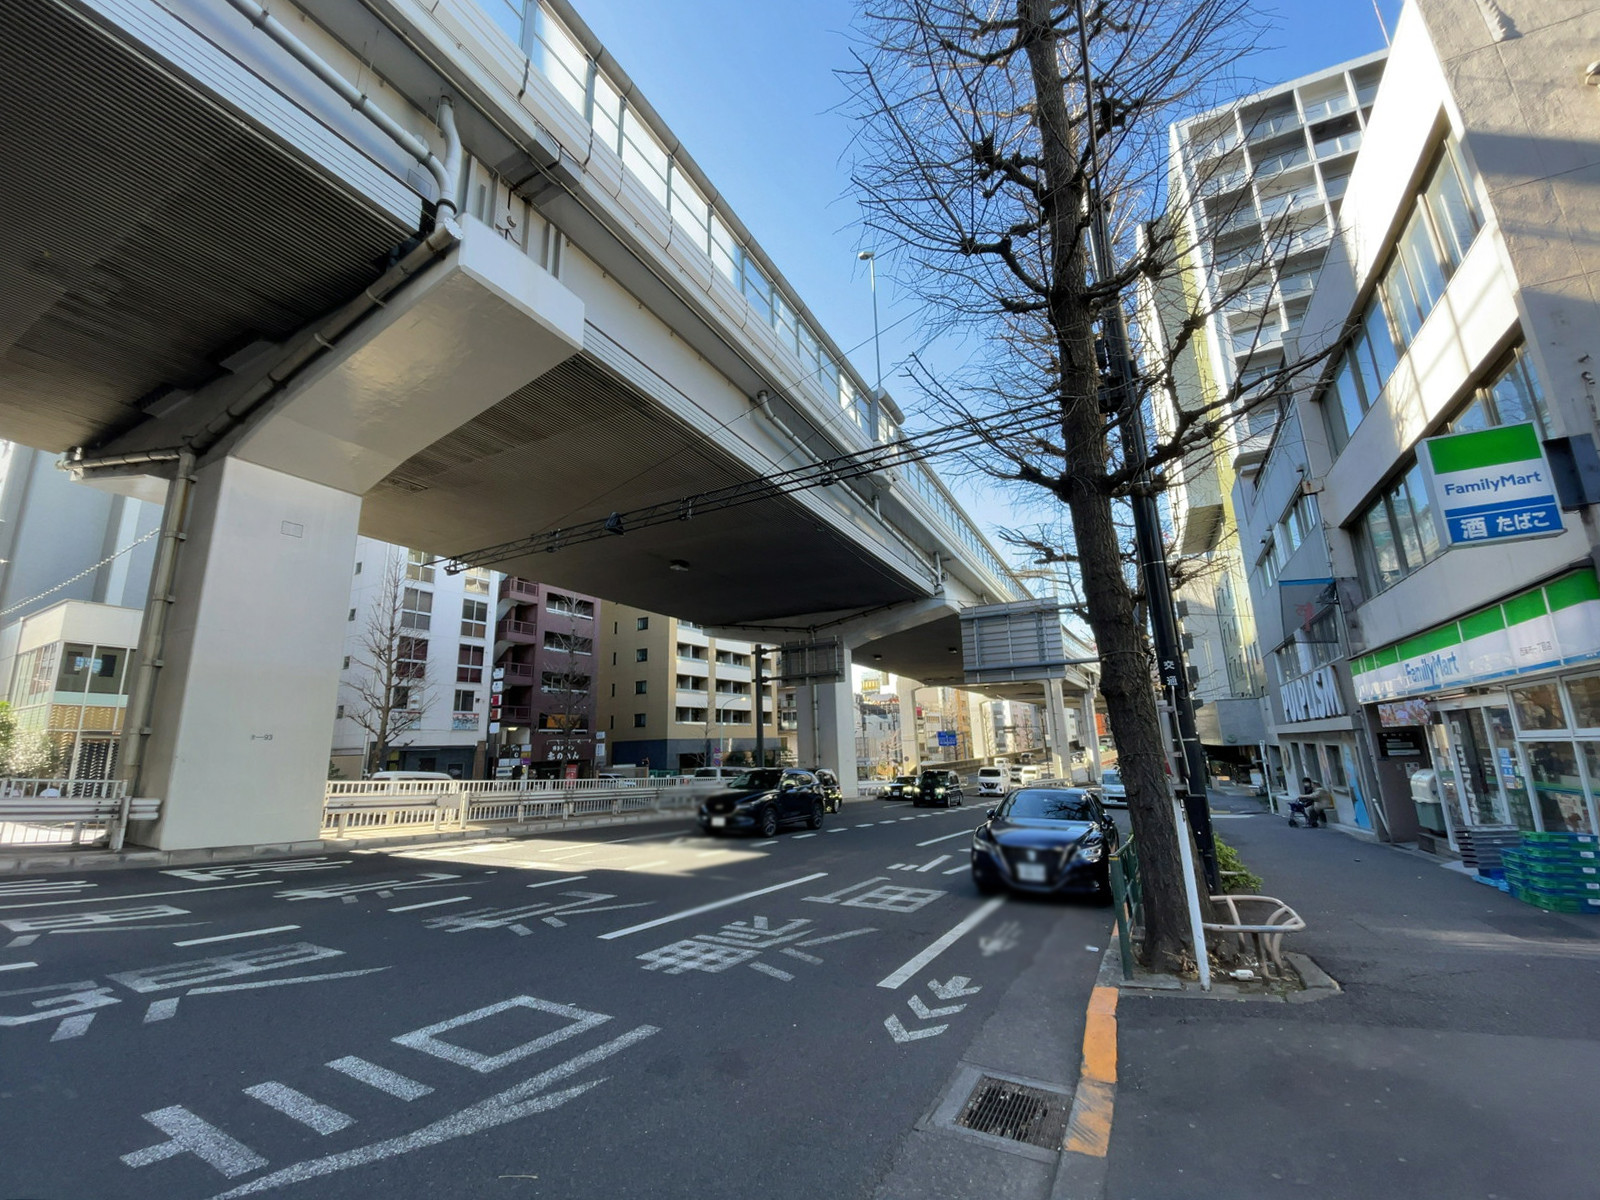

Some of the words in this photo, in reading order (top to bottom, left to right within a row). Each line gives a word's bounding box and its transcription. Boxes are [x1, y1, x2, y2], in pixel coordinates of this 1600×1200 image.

[1444, 471, 1542, 496] FamilyMart
[1460, 517, 1488, 539] 酒
[1496, 511, 1550, 532] たばこ
[1405, 652, 1460, 685] FamilyMart
